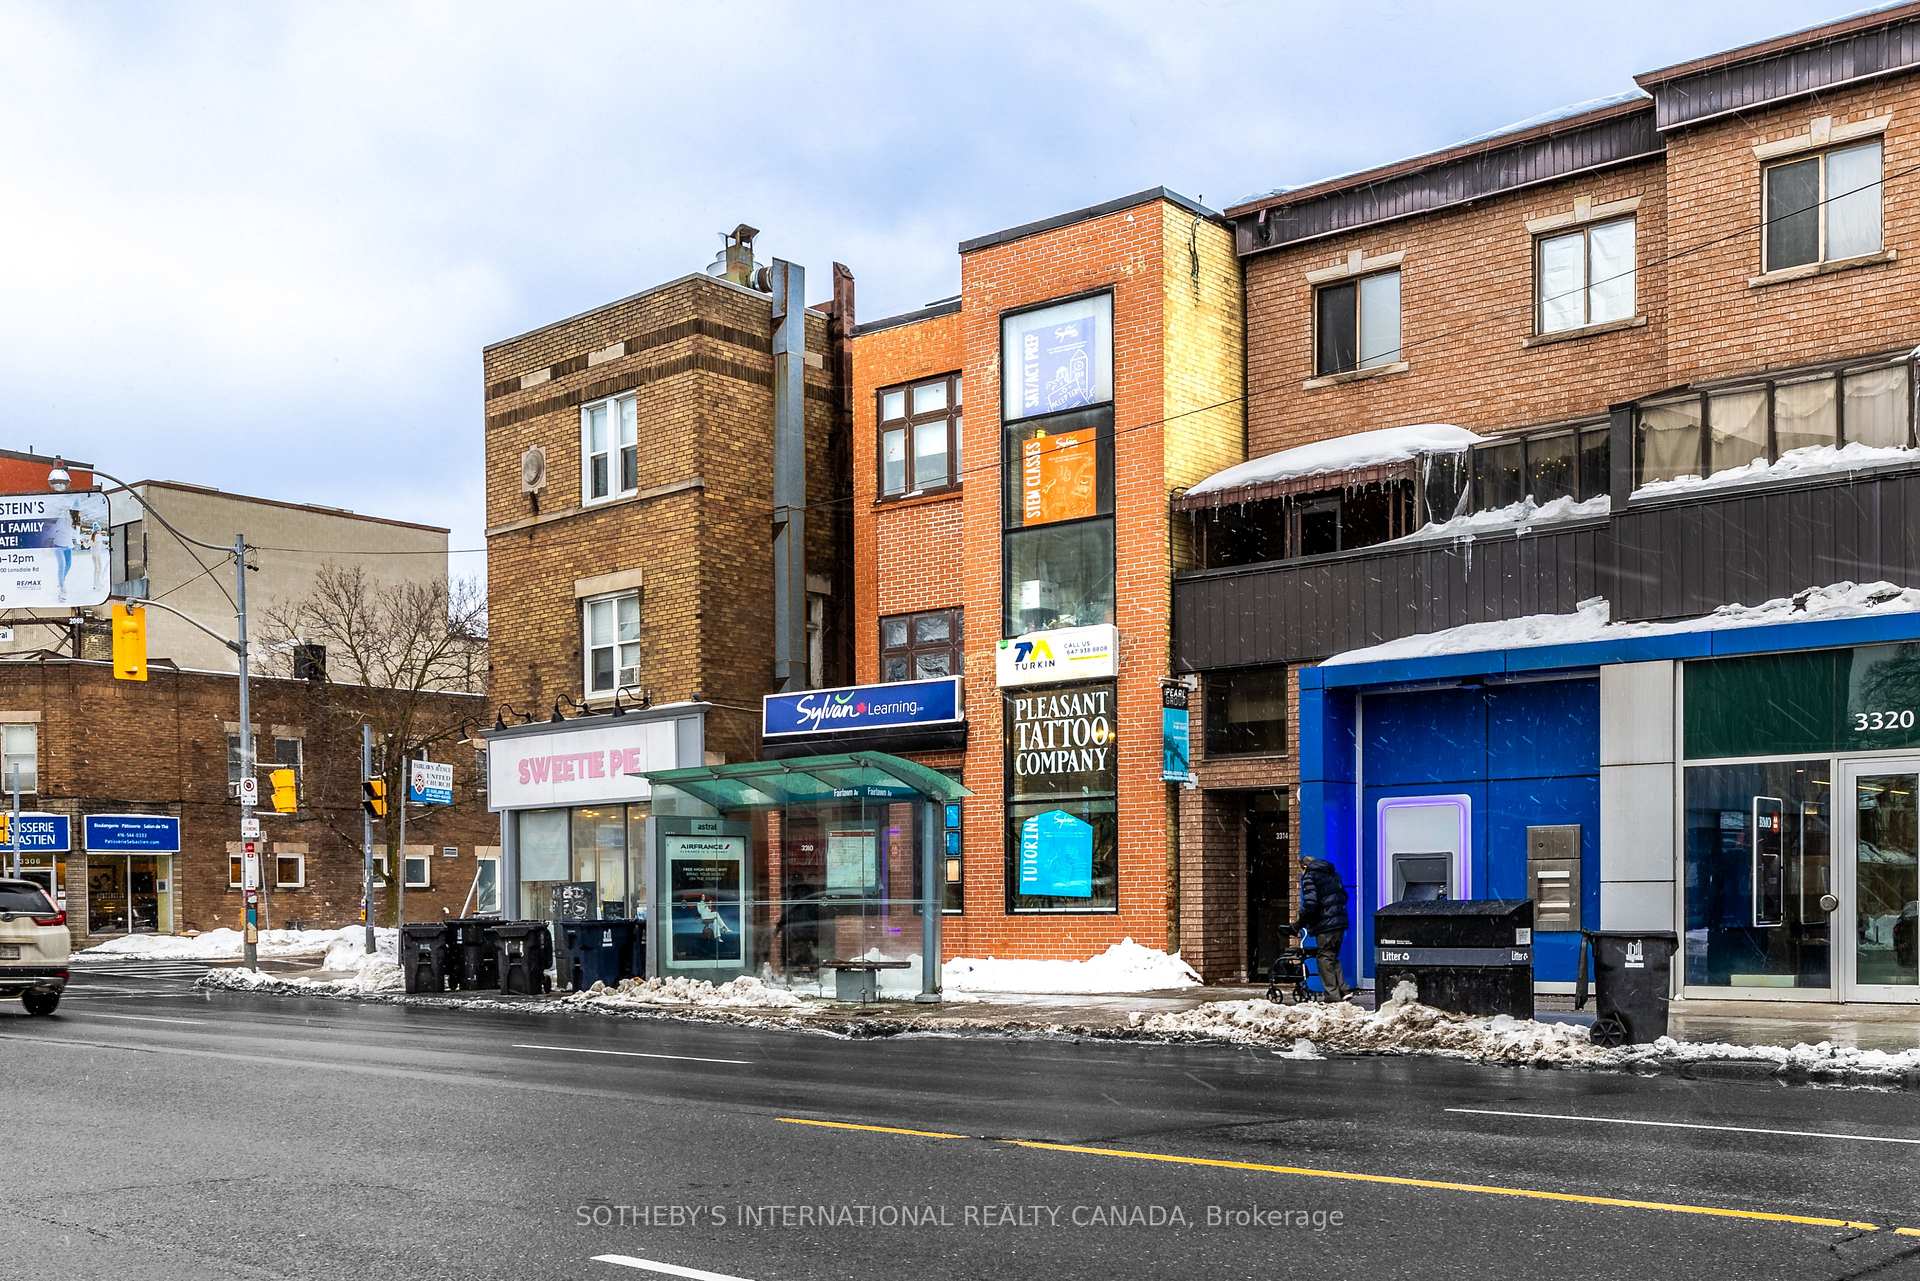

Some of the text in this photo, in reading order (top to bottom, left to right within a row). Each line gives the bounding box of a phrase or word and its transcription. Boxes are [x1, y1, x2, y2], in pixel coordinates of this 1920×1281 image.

[1024, 362, 1040, 408] SAT/ACT
[1026, 442, 1040, 518] STEM CLASSES
[8, 522, 44, 533] FAMILY
[0, 536, 18, 546] ATE!
[0, 554, 34, 564] –12pm
[1015, 660, 1055, 670] TURKIN
[1165, 688, 1186, 698] PEARL
[796, 692, 917, 731] Sylvan Learning
[1015, 691, 1108, 720] PLEASANT
[1854, 710, 1915, 731] 3320
[1015, 716, 1109, 750] TATTOO
[518, 748, 640, 784] SWEETIE PIE
[1016, 748, 1108, 776] COMPANY
[1382, 951, 1402, 961] Litter
[1512, 950, 1523, 960] Litter
